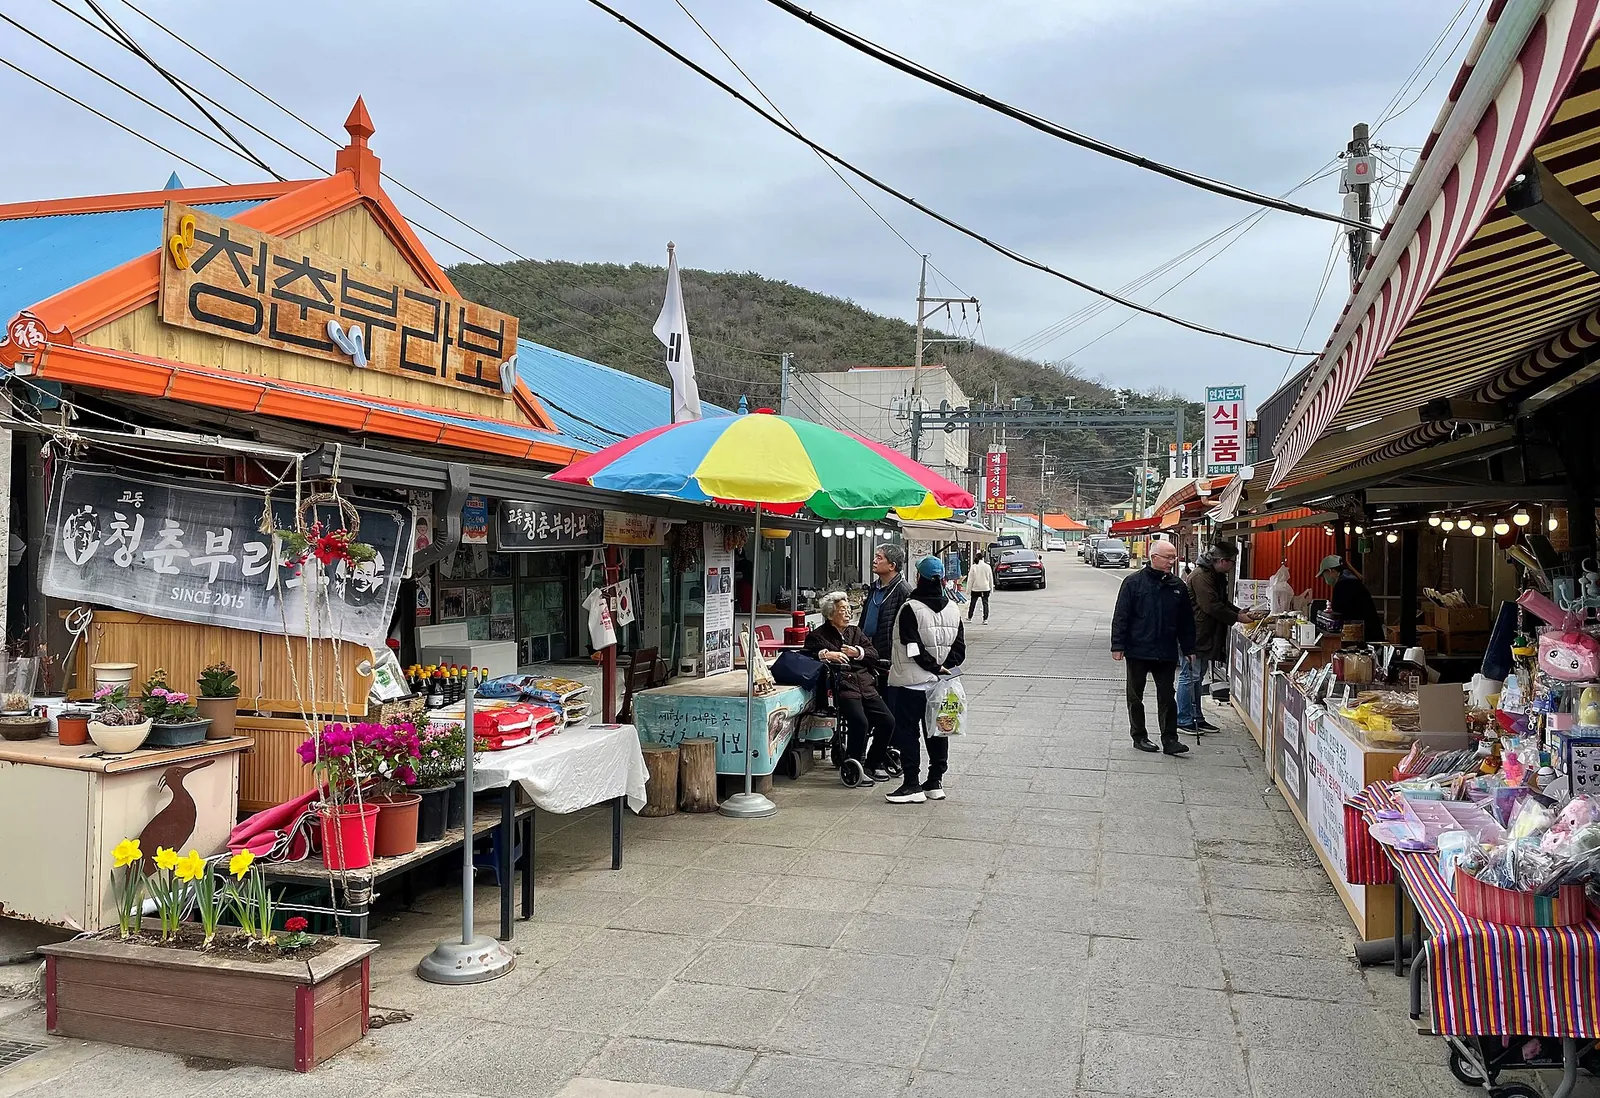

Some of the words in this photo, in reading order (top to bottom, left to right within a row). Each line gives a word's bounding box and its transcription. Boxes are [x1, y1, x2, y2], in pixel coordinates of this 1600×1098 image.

[188, 227, 505, 391] 청춘부라보
[1208, 388, 1243, 401] 연지곤지
[1212, 403, 1241, 463] 식품
[116, 490, 145, 508] 교동
[507, 508, 523, 525] 교동
[522, 511, 589, 540] 청춘부라보
[170, 587, 212, 604] SINCE
[213, 592, 245, 608] 2015
